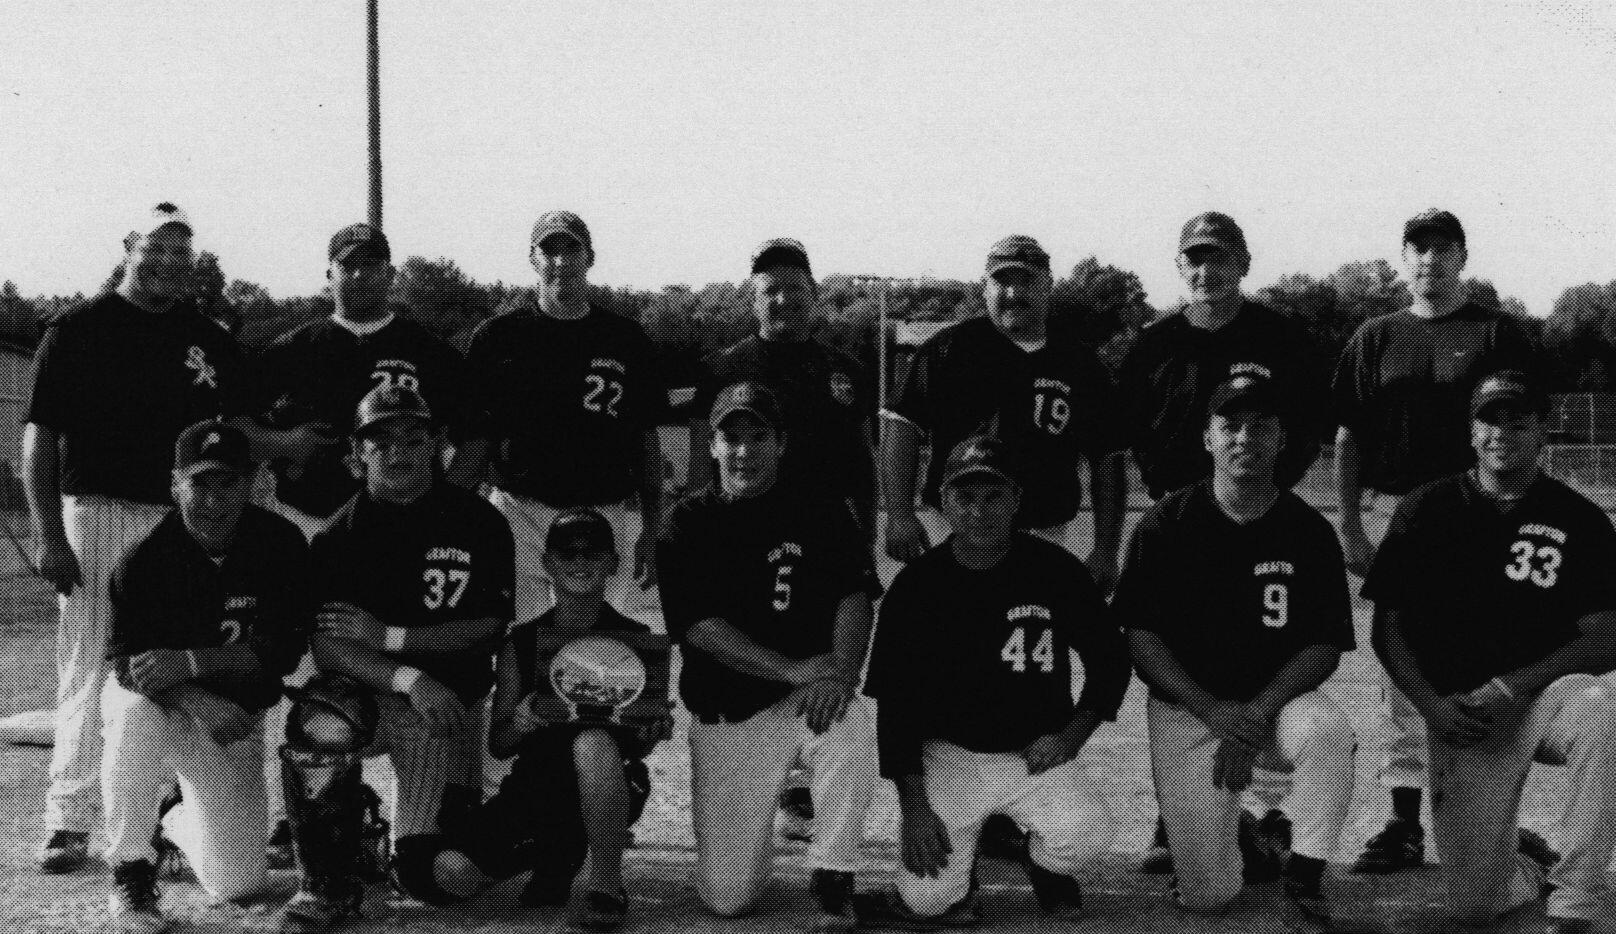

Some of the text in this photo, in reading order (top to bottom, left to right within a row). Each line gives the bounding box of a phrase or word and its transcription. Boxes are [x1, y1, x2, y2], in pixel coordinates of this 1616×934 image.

[583, 374, 623, 418] 22
[1033, 393, 1070, 434] 19
[1505, 540, 1562, 588] 33
[422, 568, 470, 609] 37
[772, 566, 792, 610] 5
[1262, 583, 1288, 628] 9
[1000, 626, 1054, 672] 44
